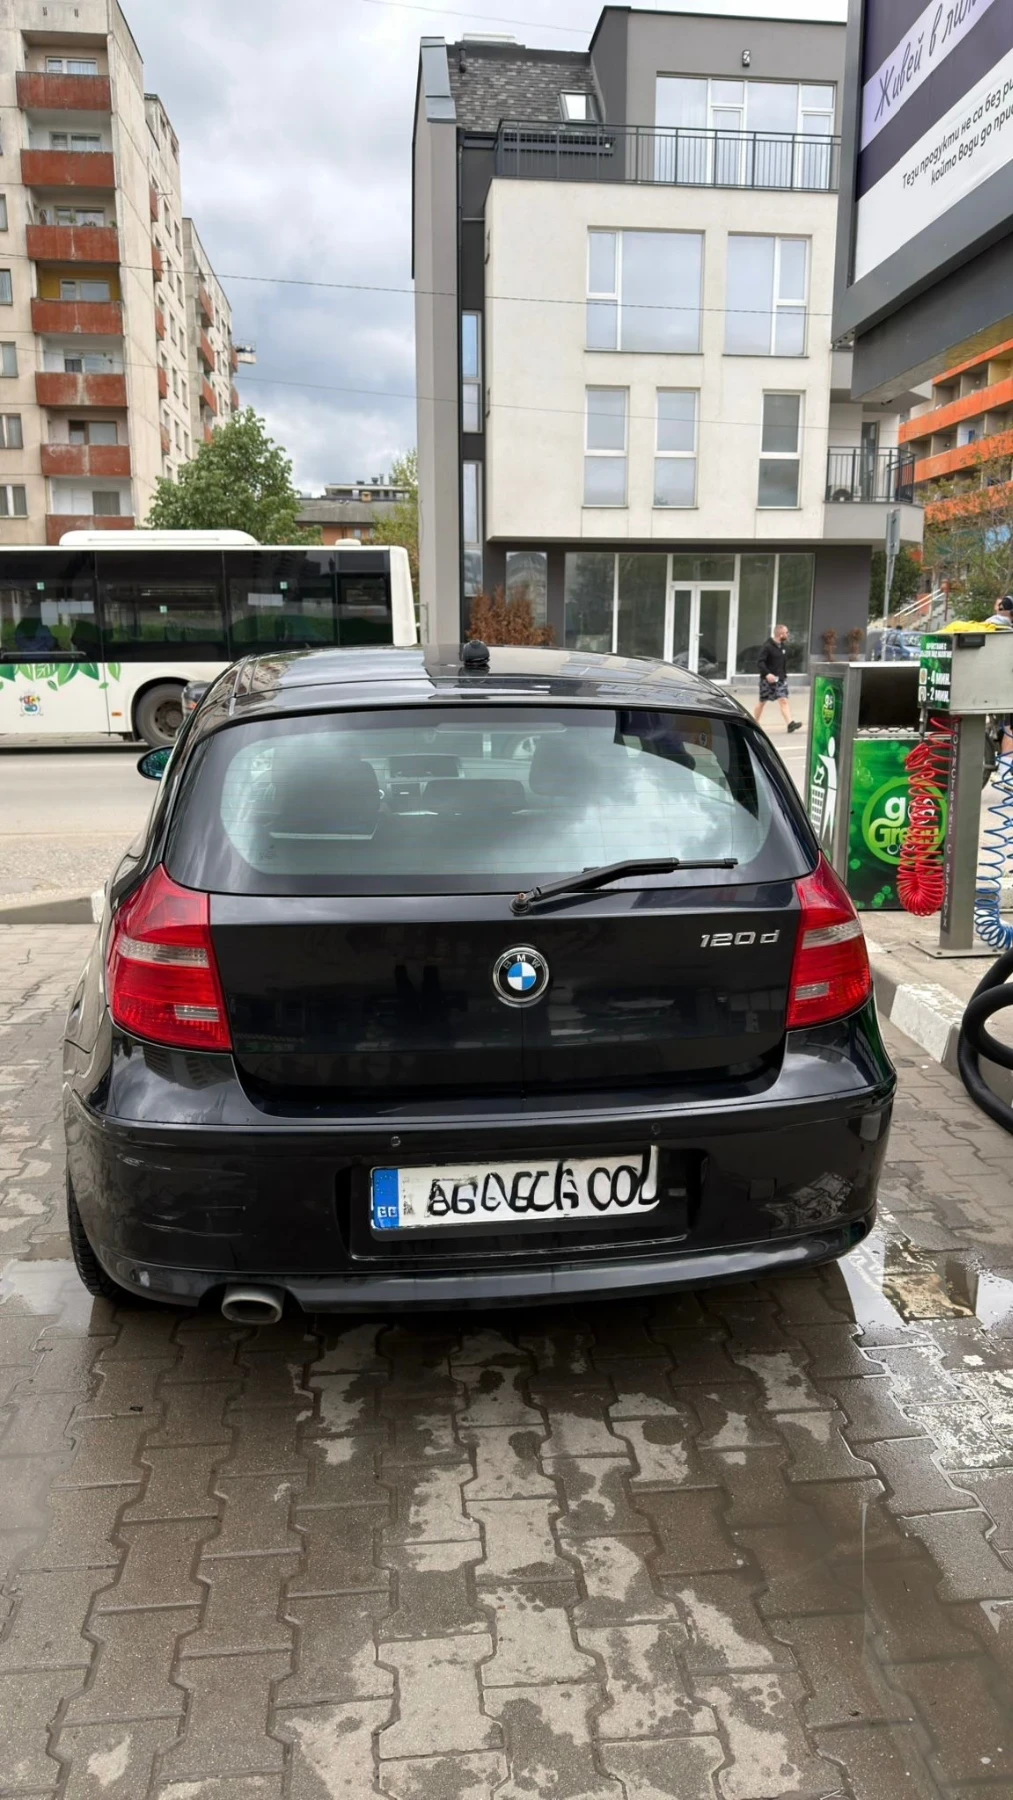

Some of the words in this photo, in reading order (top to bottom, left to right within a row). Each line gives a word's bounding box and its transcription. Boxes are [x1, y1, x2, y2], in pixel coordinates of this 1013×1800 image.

[874, 31, 925, 122] Живей
[929, 3, 943, 57] в
[902, 165, 920, 189] Тези
[920, 126, 960, 174] продукти
[961, 117, 972, 135] не
[973, 105, 983, 123] са
[985, 89, 1001, 112] без
[930, 154, 957, 186] който
[958, 133, 979, 158] води
[980, 123, 993, 147] до
[868, 818, 940, 848] Gren
[502, 954, 541, 969] BMW
